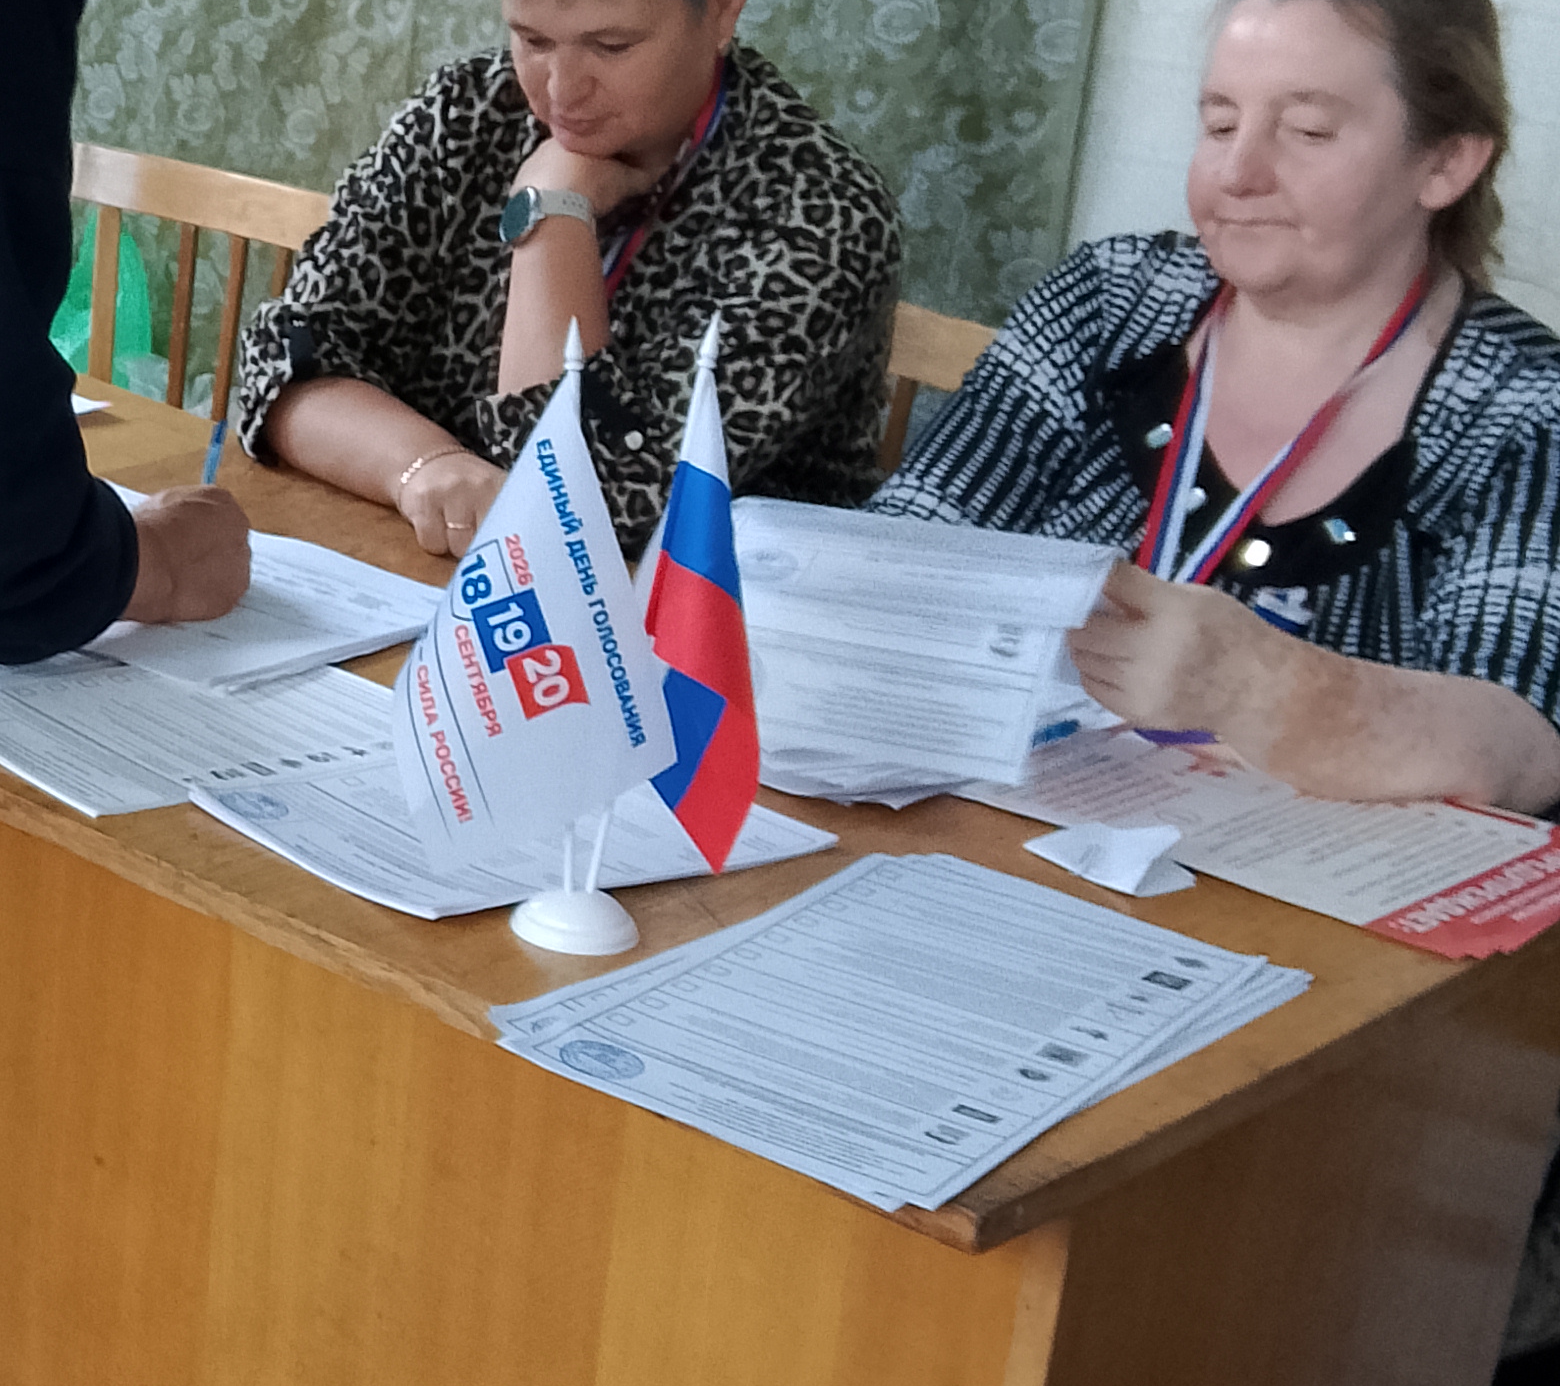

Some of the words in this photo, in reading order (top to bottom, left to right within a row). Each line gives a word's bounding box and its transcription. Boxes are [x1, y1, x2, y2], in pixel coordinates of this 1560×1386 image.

[460, 553, 492, 605] 18
[486, 601, 532, 653] 19
[522, 649, 571, 707] 20
[504, 533, 534, 587] 2026
[536, 438, 584, 535] ЕДИНЫЙ
[565, 539, 599, 596] ДЕНЬ
[588, 598, 647, 748] ГОЛОСОВАНИЯ
[416, 665, 439, 726] СИЛА
[430, 730, 474, 824] РОССИИ!
[454, 624, 503, 738] СЕНТЯБРЯ
